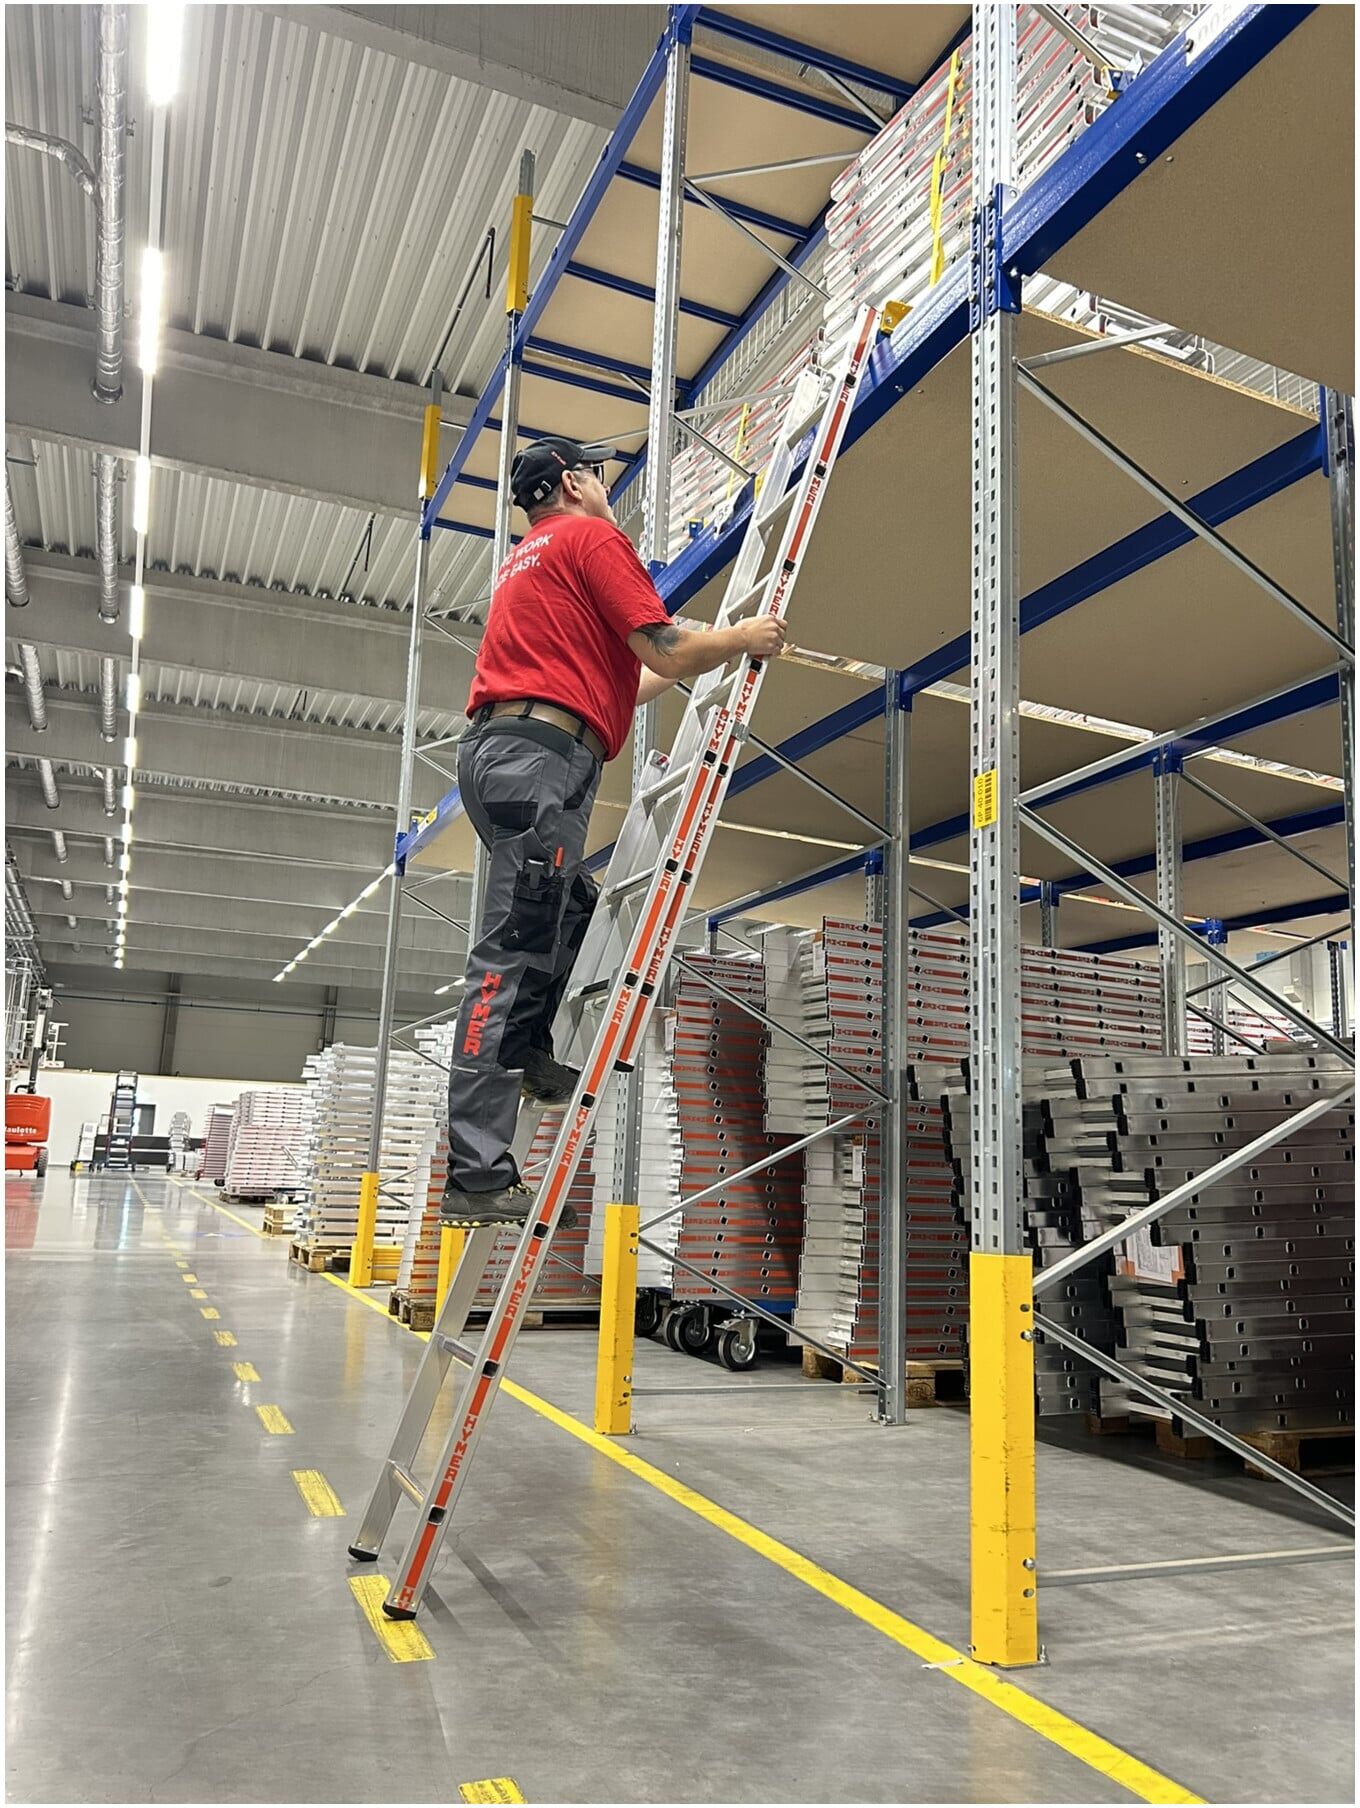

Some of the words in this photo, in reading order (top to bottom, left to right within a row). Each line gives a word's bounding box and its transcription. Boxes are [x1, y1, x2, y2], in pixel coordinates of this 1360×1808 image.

[509, 552, 541, 578] EASY.
[515, 533, 554, 560] WORK
[735, 683, 754, 723] HYME
[690, 802, 714, 854] HYMER
[644, 927, 673, 984] HYMER
[463, 970, 502, 1056] HYMER
[504, 1254, 536, 1319] HYMER
[444, 1415, 478, 1483] HYMER
